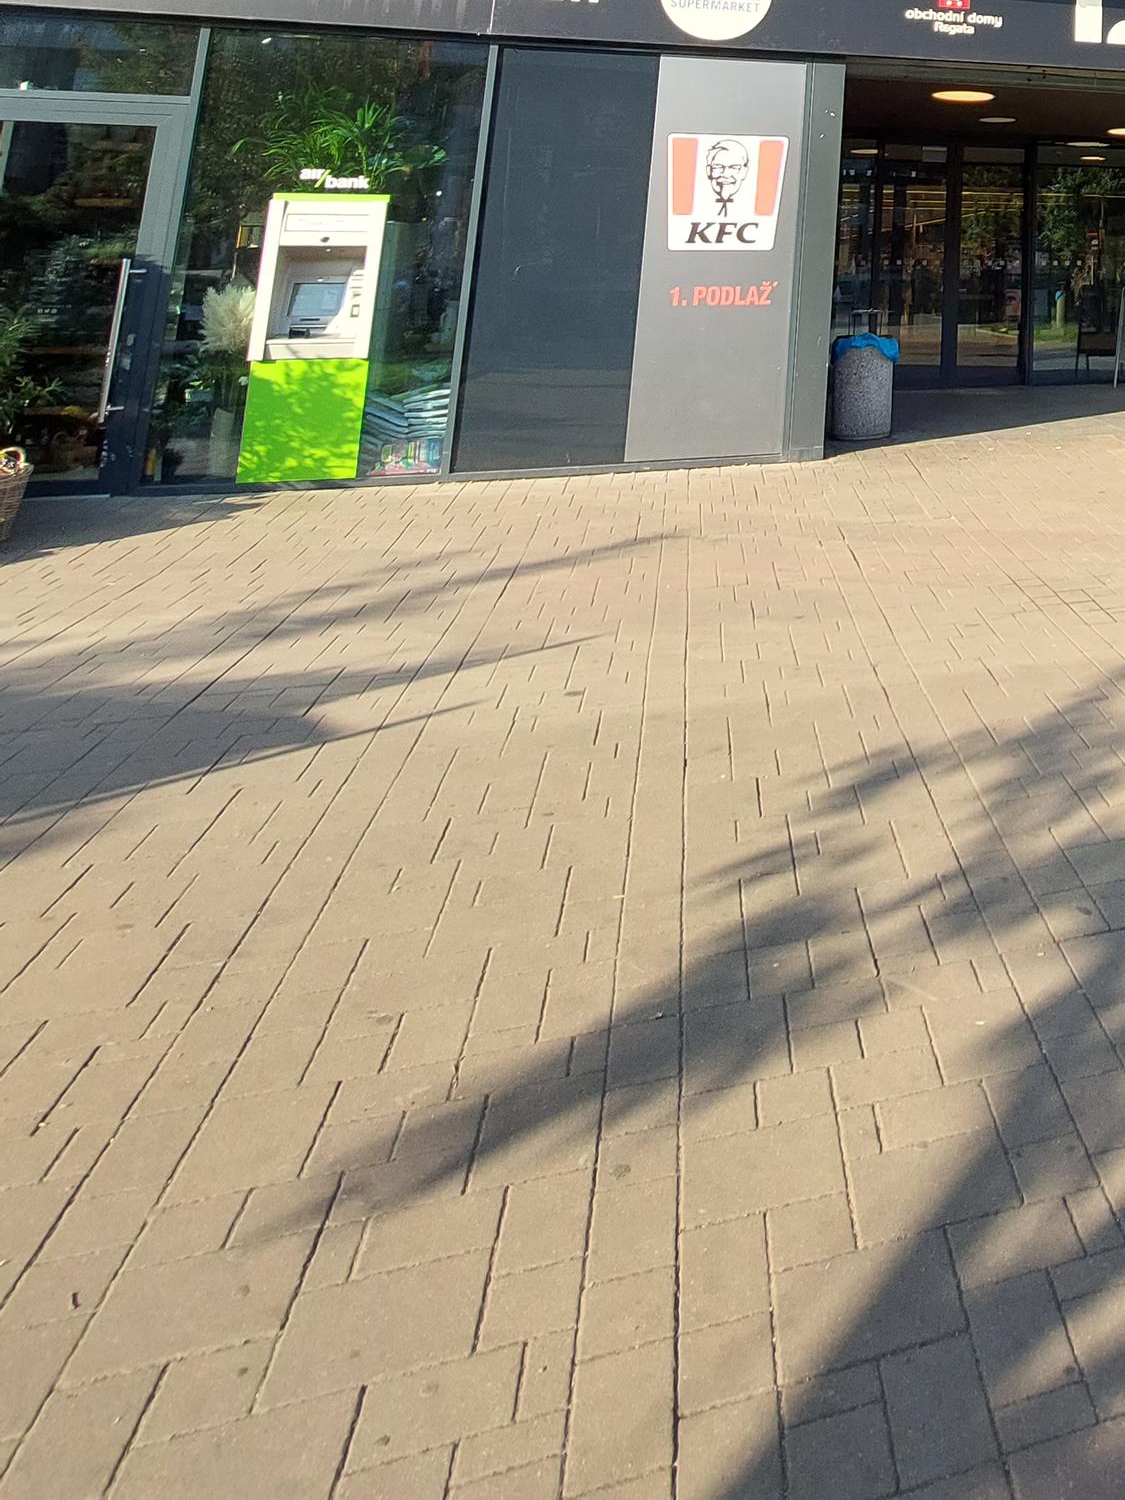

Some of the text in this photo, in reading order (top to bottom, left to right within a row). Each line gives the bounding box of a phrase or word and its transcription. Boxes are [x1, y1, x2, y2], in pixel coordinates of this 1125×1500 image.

[905, 8, 1003, 28] obchodní domy
[933, 21, 975, 35] Regata
[685, 222, 759, 244] KFC
[670, 281, 778, 307] 1. PODLAŽ
